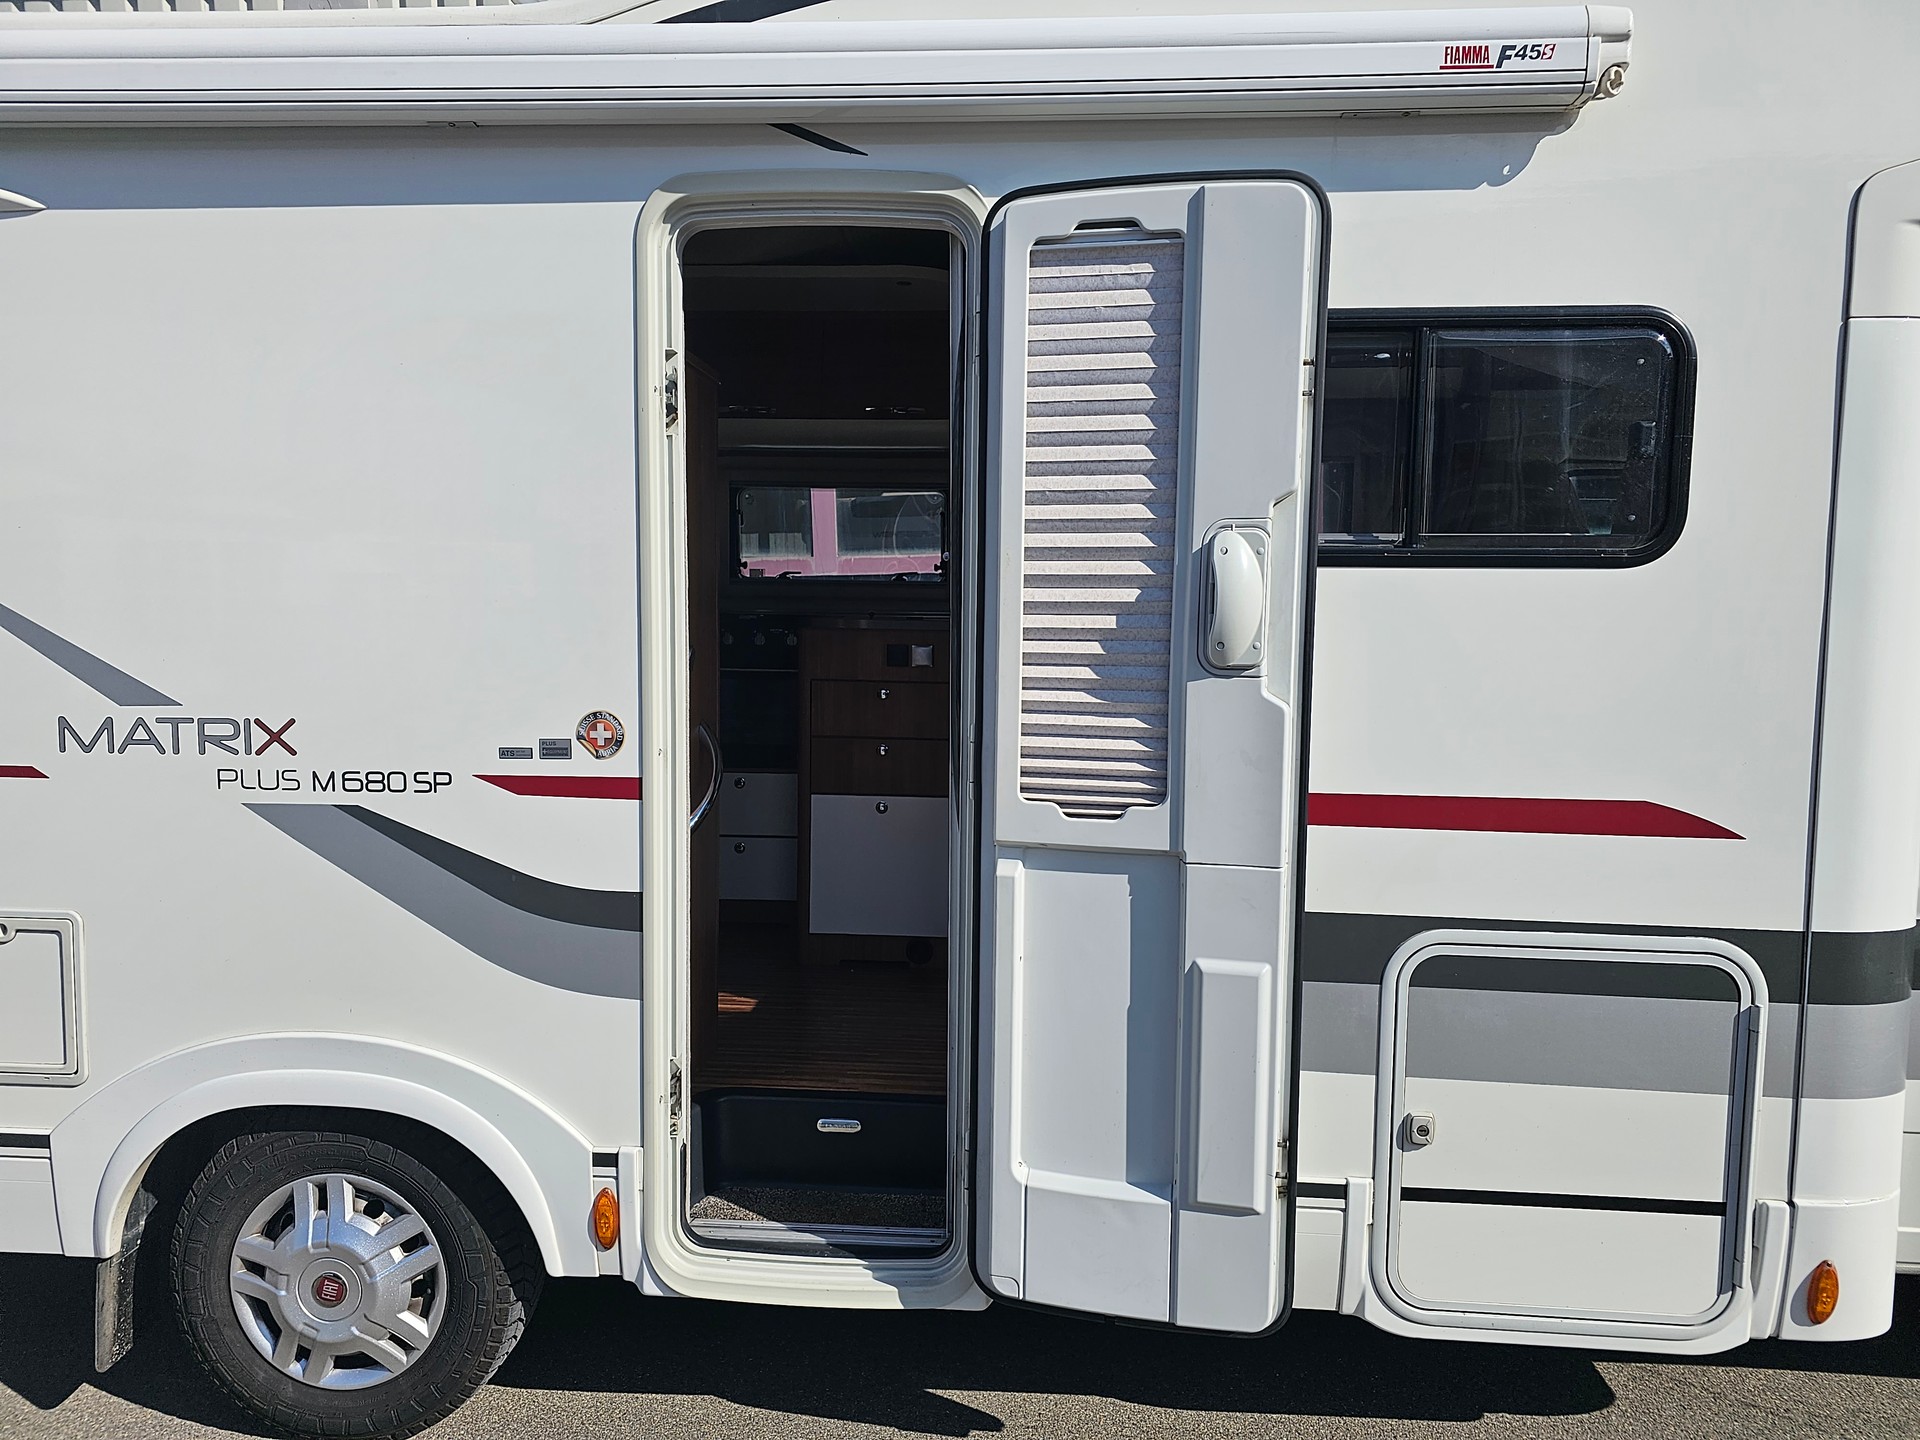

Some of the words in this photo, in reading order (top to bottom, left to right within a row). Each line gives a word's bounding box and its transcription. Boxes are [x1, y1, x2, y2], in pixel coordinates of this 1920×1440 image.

[1444, 45, 1490, 64] FIAMMA
[1495, 43, 1556, 69] F45S
[57, 715, 298, 756] MATRIX
[578, 713, 596, 736] SUISSE
[596, 712, 623, 741] STANDARD
[597, 745, 618, 757] ADRIA
[217, 768, 301, 791] PLUS
[321, 1279, 339, 1301] FIAT
